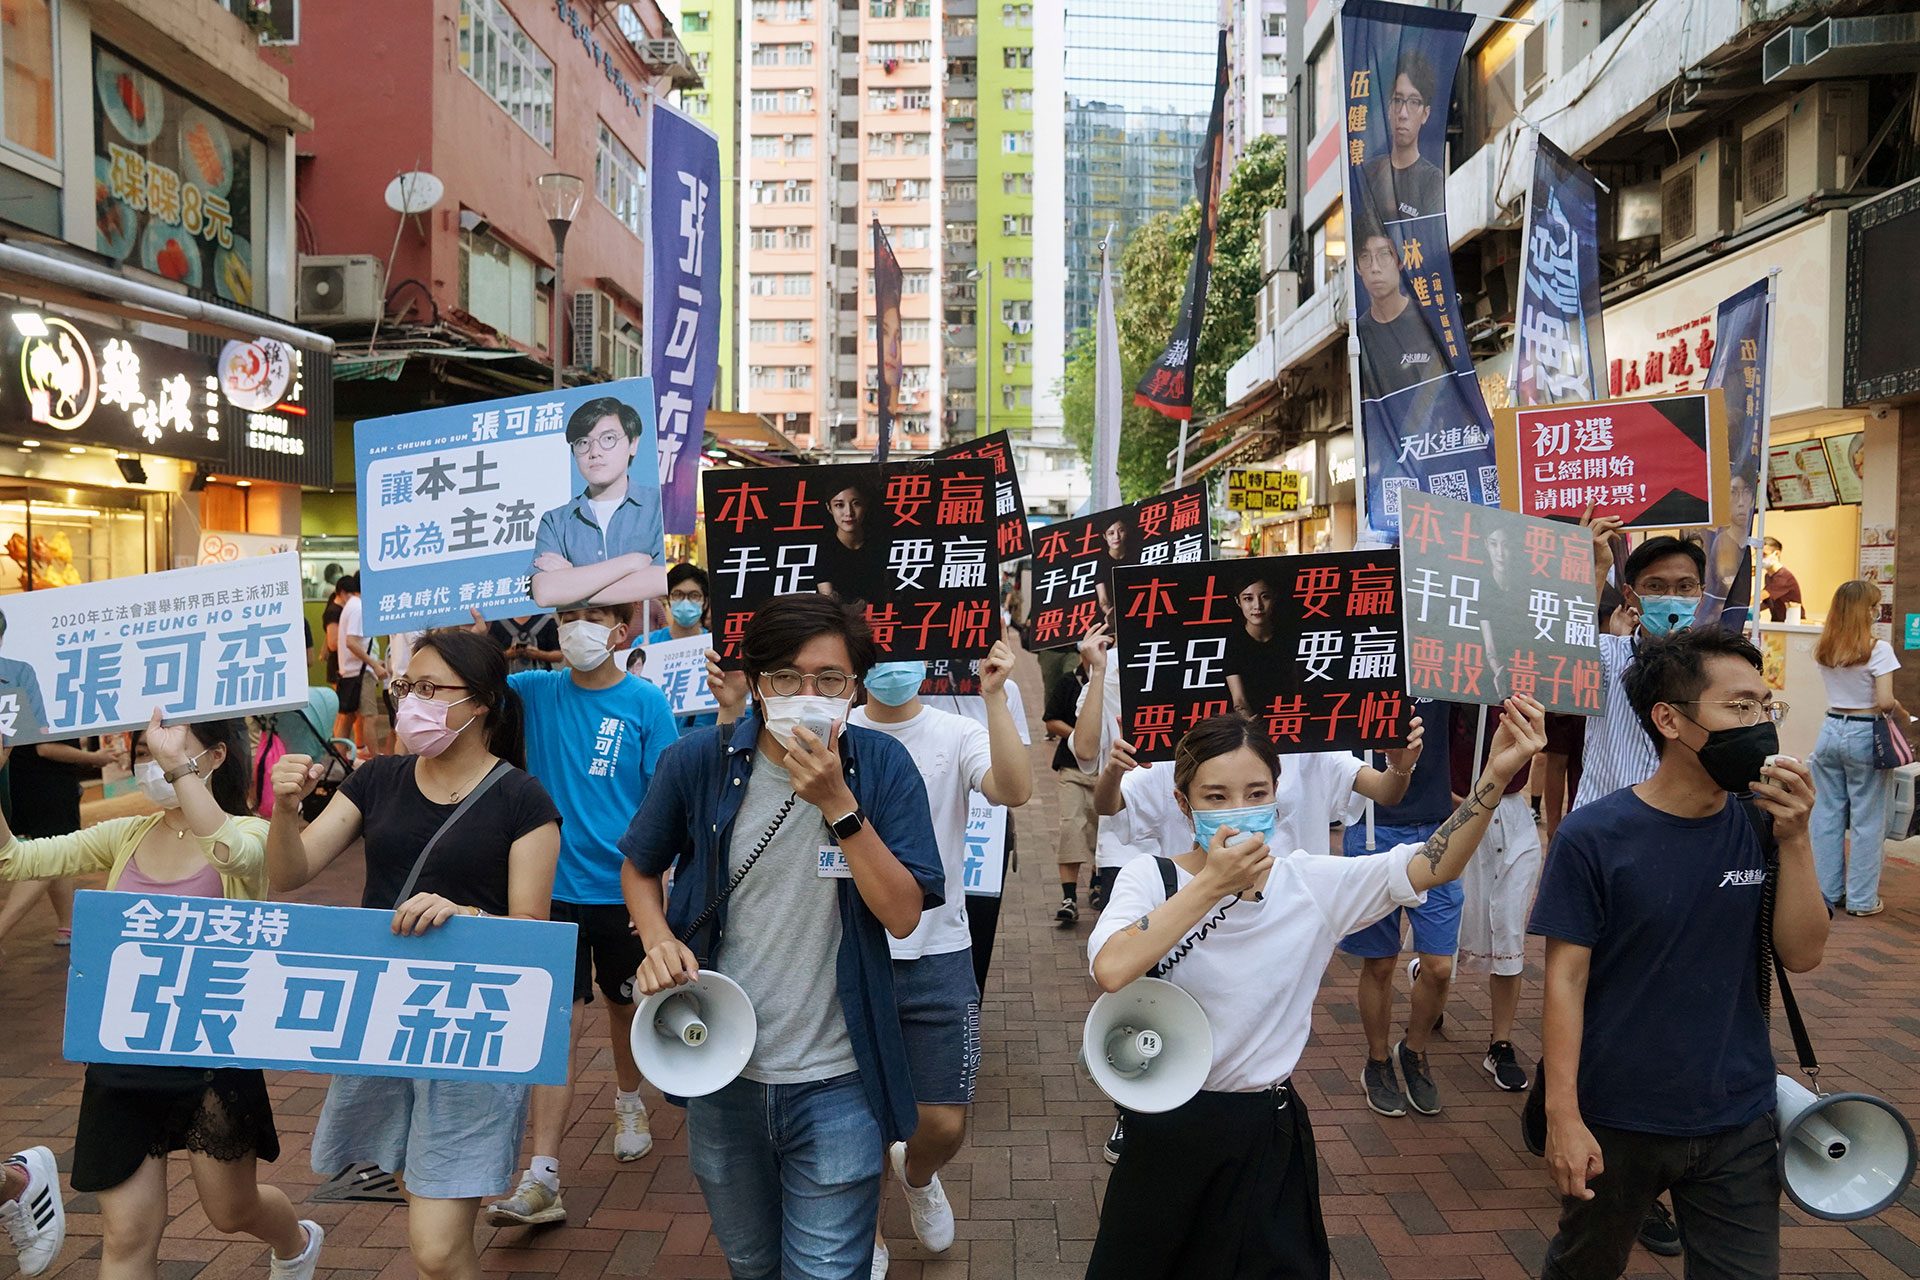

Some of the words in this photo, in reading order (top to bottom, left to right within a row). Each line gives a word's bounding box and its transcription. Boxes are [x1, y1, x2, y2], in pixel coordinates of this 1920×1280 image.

[108, 142, 235, 250] 碟碟8元
[249, 431, 305, 456] EXPRESS
[369, 445, 388, 455] SAM
[397, 439, 432, 450] CHEUNG
[434, 436, 447, 445] HO
[450, 433, 468, 442] SUM
[471, 401, 566, 443] 張可森
[1397, 425, 1490, 464] 天水連線
[1531, 416, 1614, 457] 初選
[380, 449, 501, 507] 讓本土
[1533, 455, 1635, 483] 已經開始
[714, 480, 824, 534] 本土
[883, 471, 986, 527] 要贏
[1230, 491, 1298, 510] 手機配件
[378, 498, 537, 563] 成為主流
[1036, 523, 1102, 564] 本土
[1137, 492, 1201, 540] 要贏
[1405, 501, 1485, 566] 本土
[1524, 524, 1593, 585] 要贏
[458, 575, 531, 603] 香港重光
[716, 543, 819, 599] 手足
[886, 535, 988, 591] 要贏
[1035, 560, 1098, 605] 手足
[51, 580, 290, 629] 2020年立法會選舉新界西民主派初選
[379, 612, 406, 622] BREAK
[409, 609, 425, 618] THE
[427, 606, 451, 616] DAWN
[459, 603, 480, 611] FREE
[483, 599, 505, 608] HONG
[508, 595, 531, 604] KONG
[1035, 600, 1098, 642] 票投
[1125, 575, 1232, 628] 本土
[1293, 562, 1396, 619] 要贏
[1407, 567, 1481, 631] 手足
[1528, 588, 1597, 648] 要贏
[56, 629, 97, 646] SAM
[120, 615, 198, 637] CHEUNG
[206, 609, 234, 625] HO
[242, 601, 284, 618] SUM
[54, 622, 292, 728] 張可森
[1127, 637, 1227, 693] 手足
[1295, 626, 1398, 682] 要贏
[1412, 636, 1485, 697] 票投
[588, 717, 620, 777] 張可森
[970, 807, 993, 819] 初選
[120, 898, 290, 948] 全力支持
[124, 943, 522, 1068] 張可森
[959, 1016, 969, 1089] CALIFORNIA
